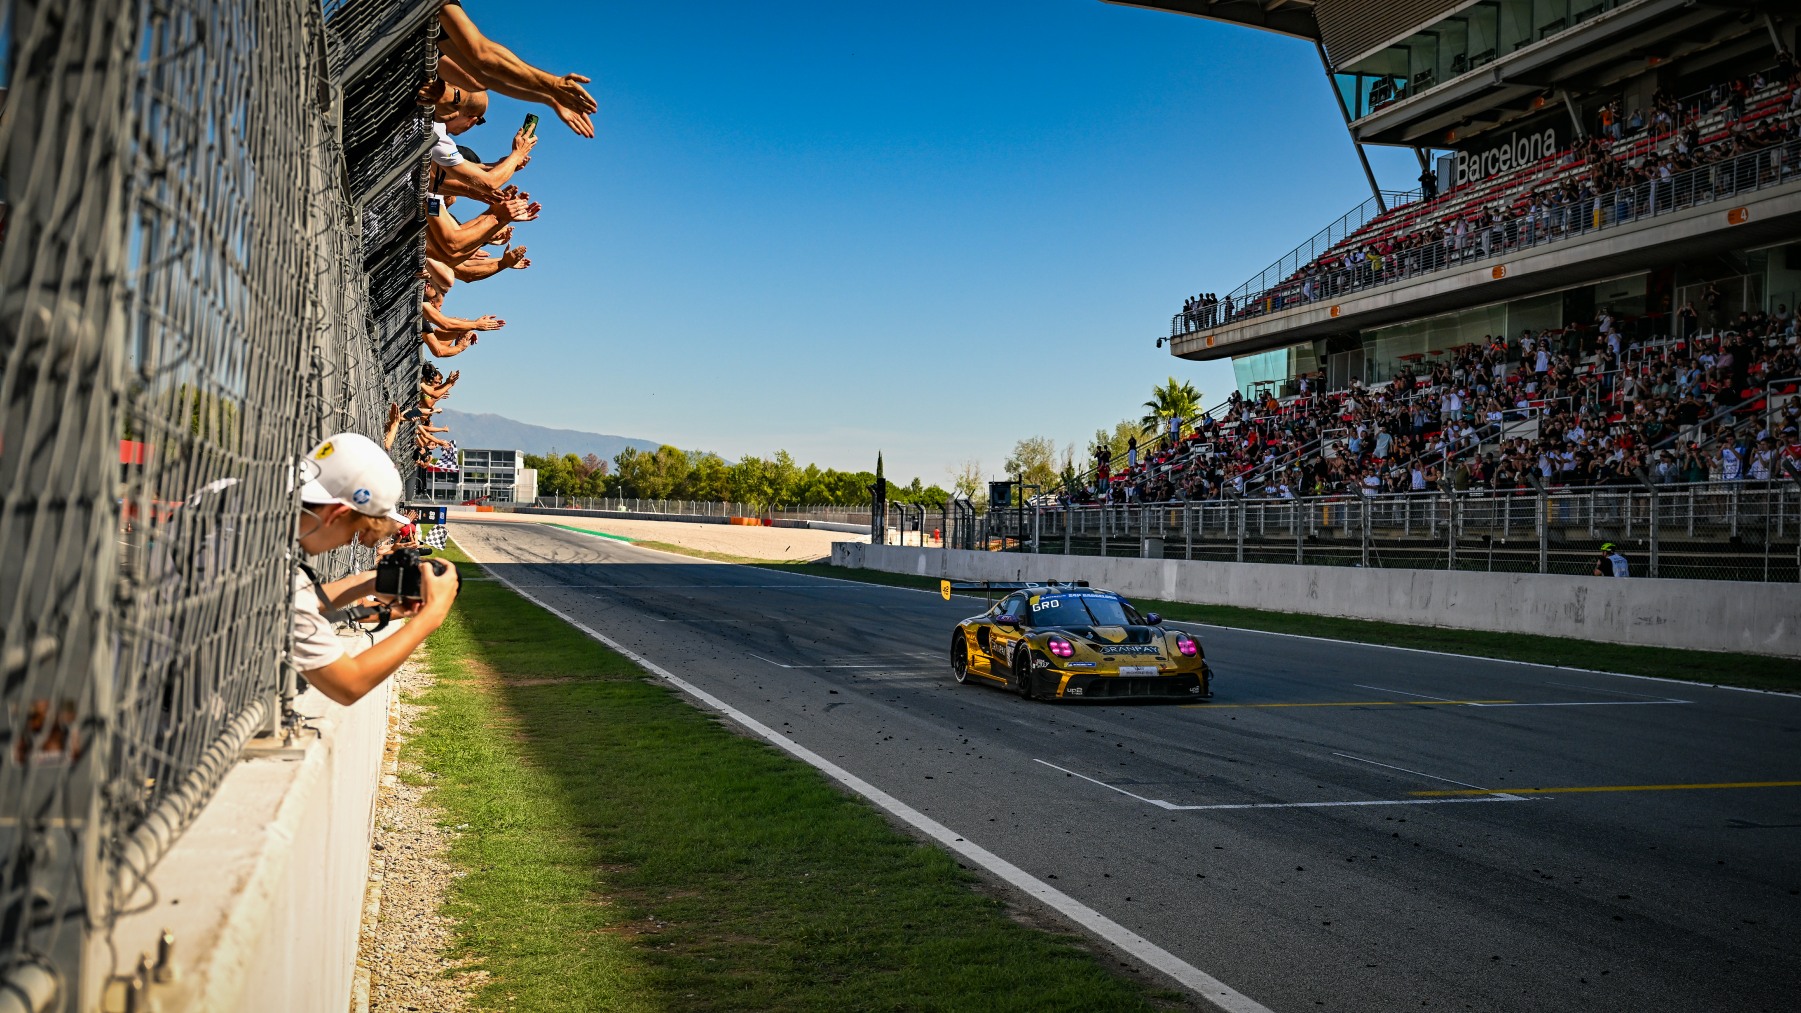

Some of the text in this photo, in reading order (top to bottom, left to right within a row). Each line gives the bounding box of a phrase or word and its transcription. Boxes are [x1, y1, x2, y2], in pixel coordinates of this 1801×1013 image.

[1456, 128, 1557, 187] Barcelona
[1740, 208, 1748, 222] 4
[1032, 599, 1060, 612] GRO
